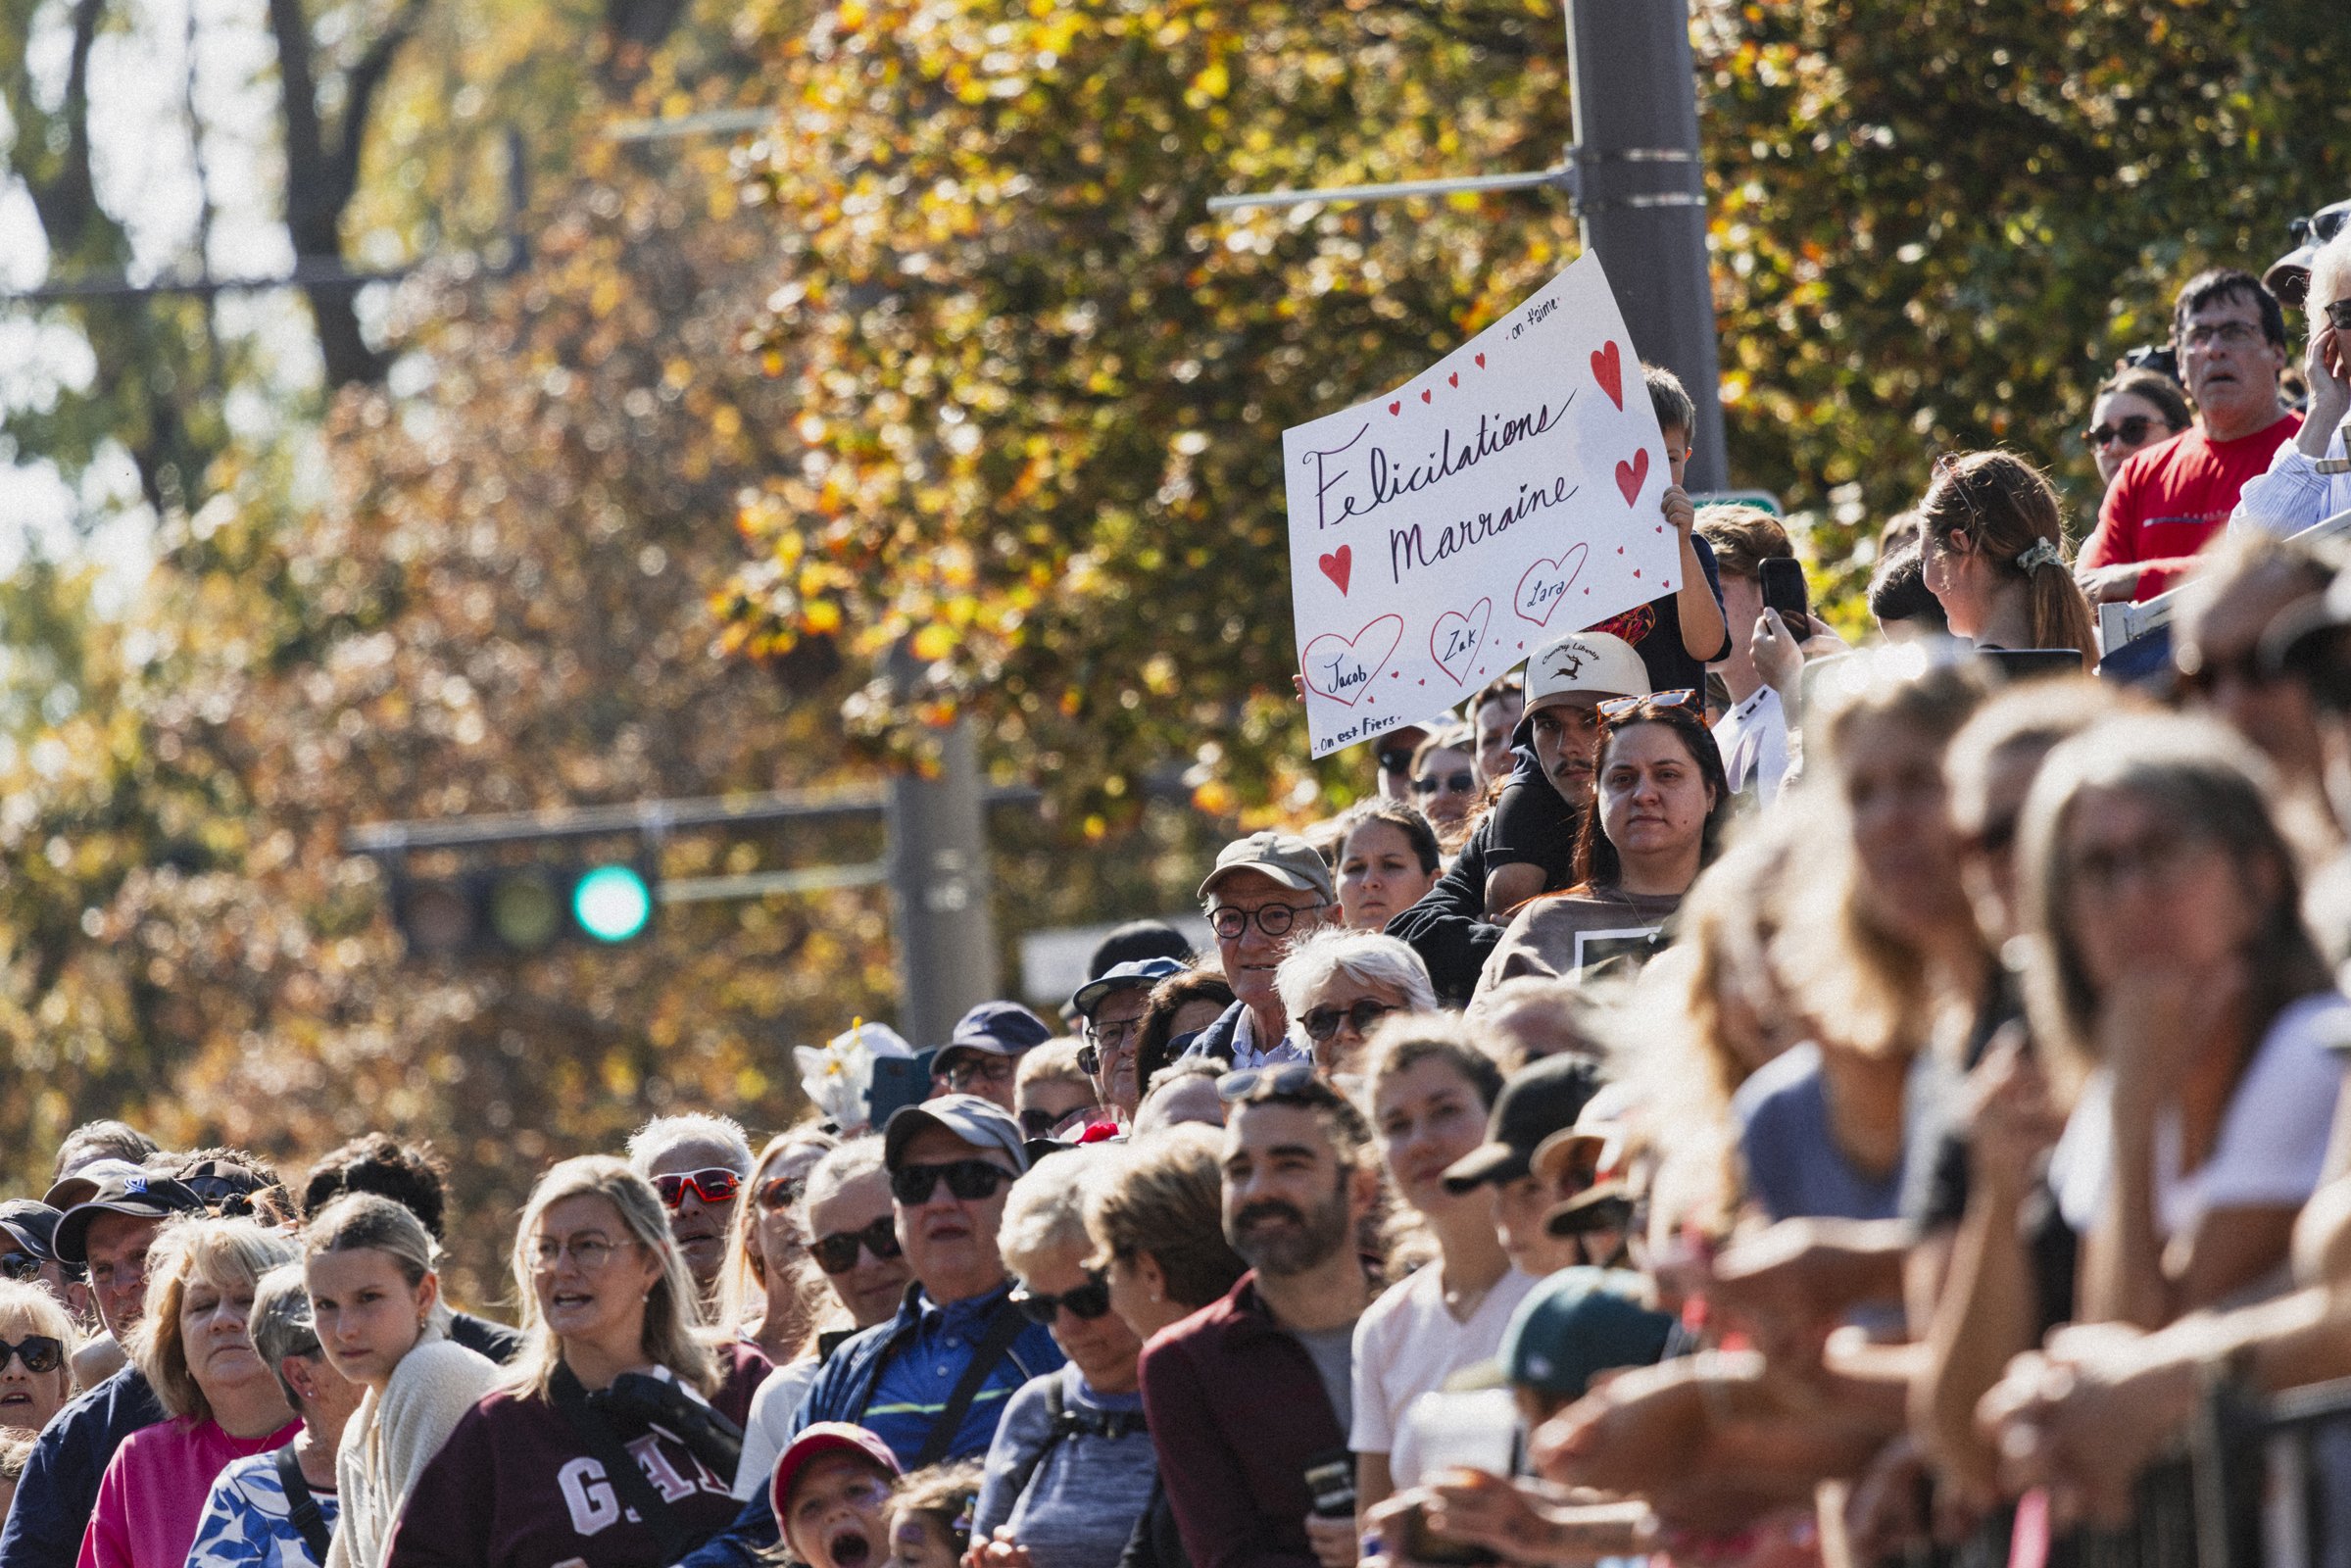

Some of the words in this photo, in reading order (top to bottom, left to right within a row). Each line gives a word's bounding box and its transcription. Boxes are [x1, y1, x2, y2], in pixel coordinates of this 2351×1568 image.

[1511, 322, 1525, 340] on
[1390, 477, 1579, 584] Marraine
[1527, 580, 1565, 608] Lara
[1444, 629, 1477, 662] Zak
[1542, 643, 1571, 665] Country
[1572, 642, 1600, 661] Liberty
[1324, 653, 1367, 693] Jacob
[1320, 738, 1335, 752] On
[1338, 726, 1358, 743] est
[557, 1433, 731, 1537] GA
